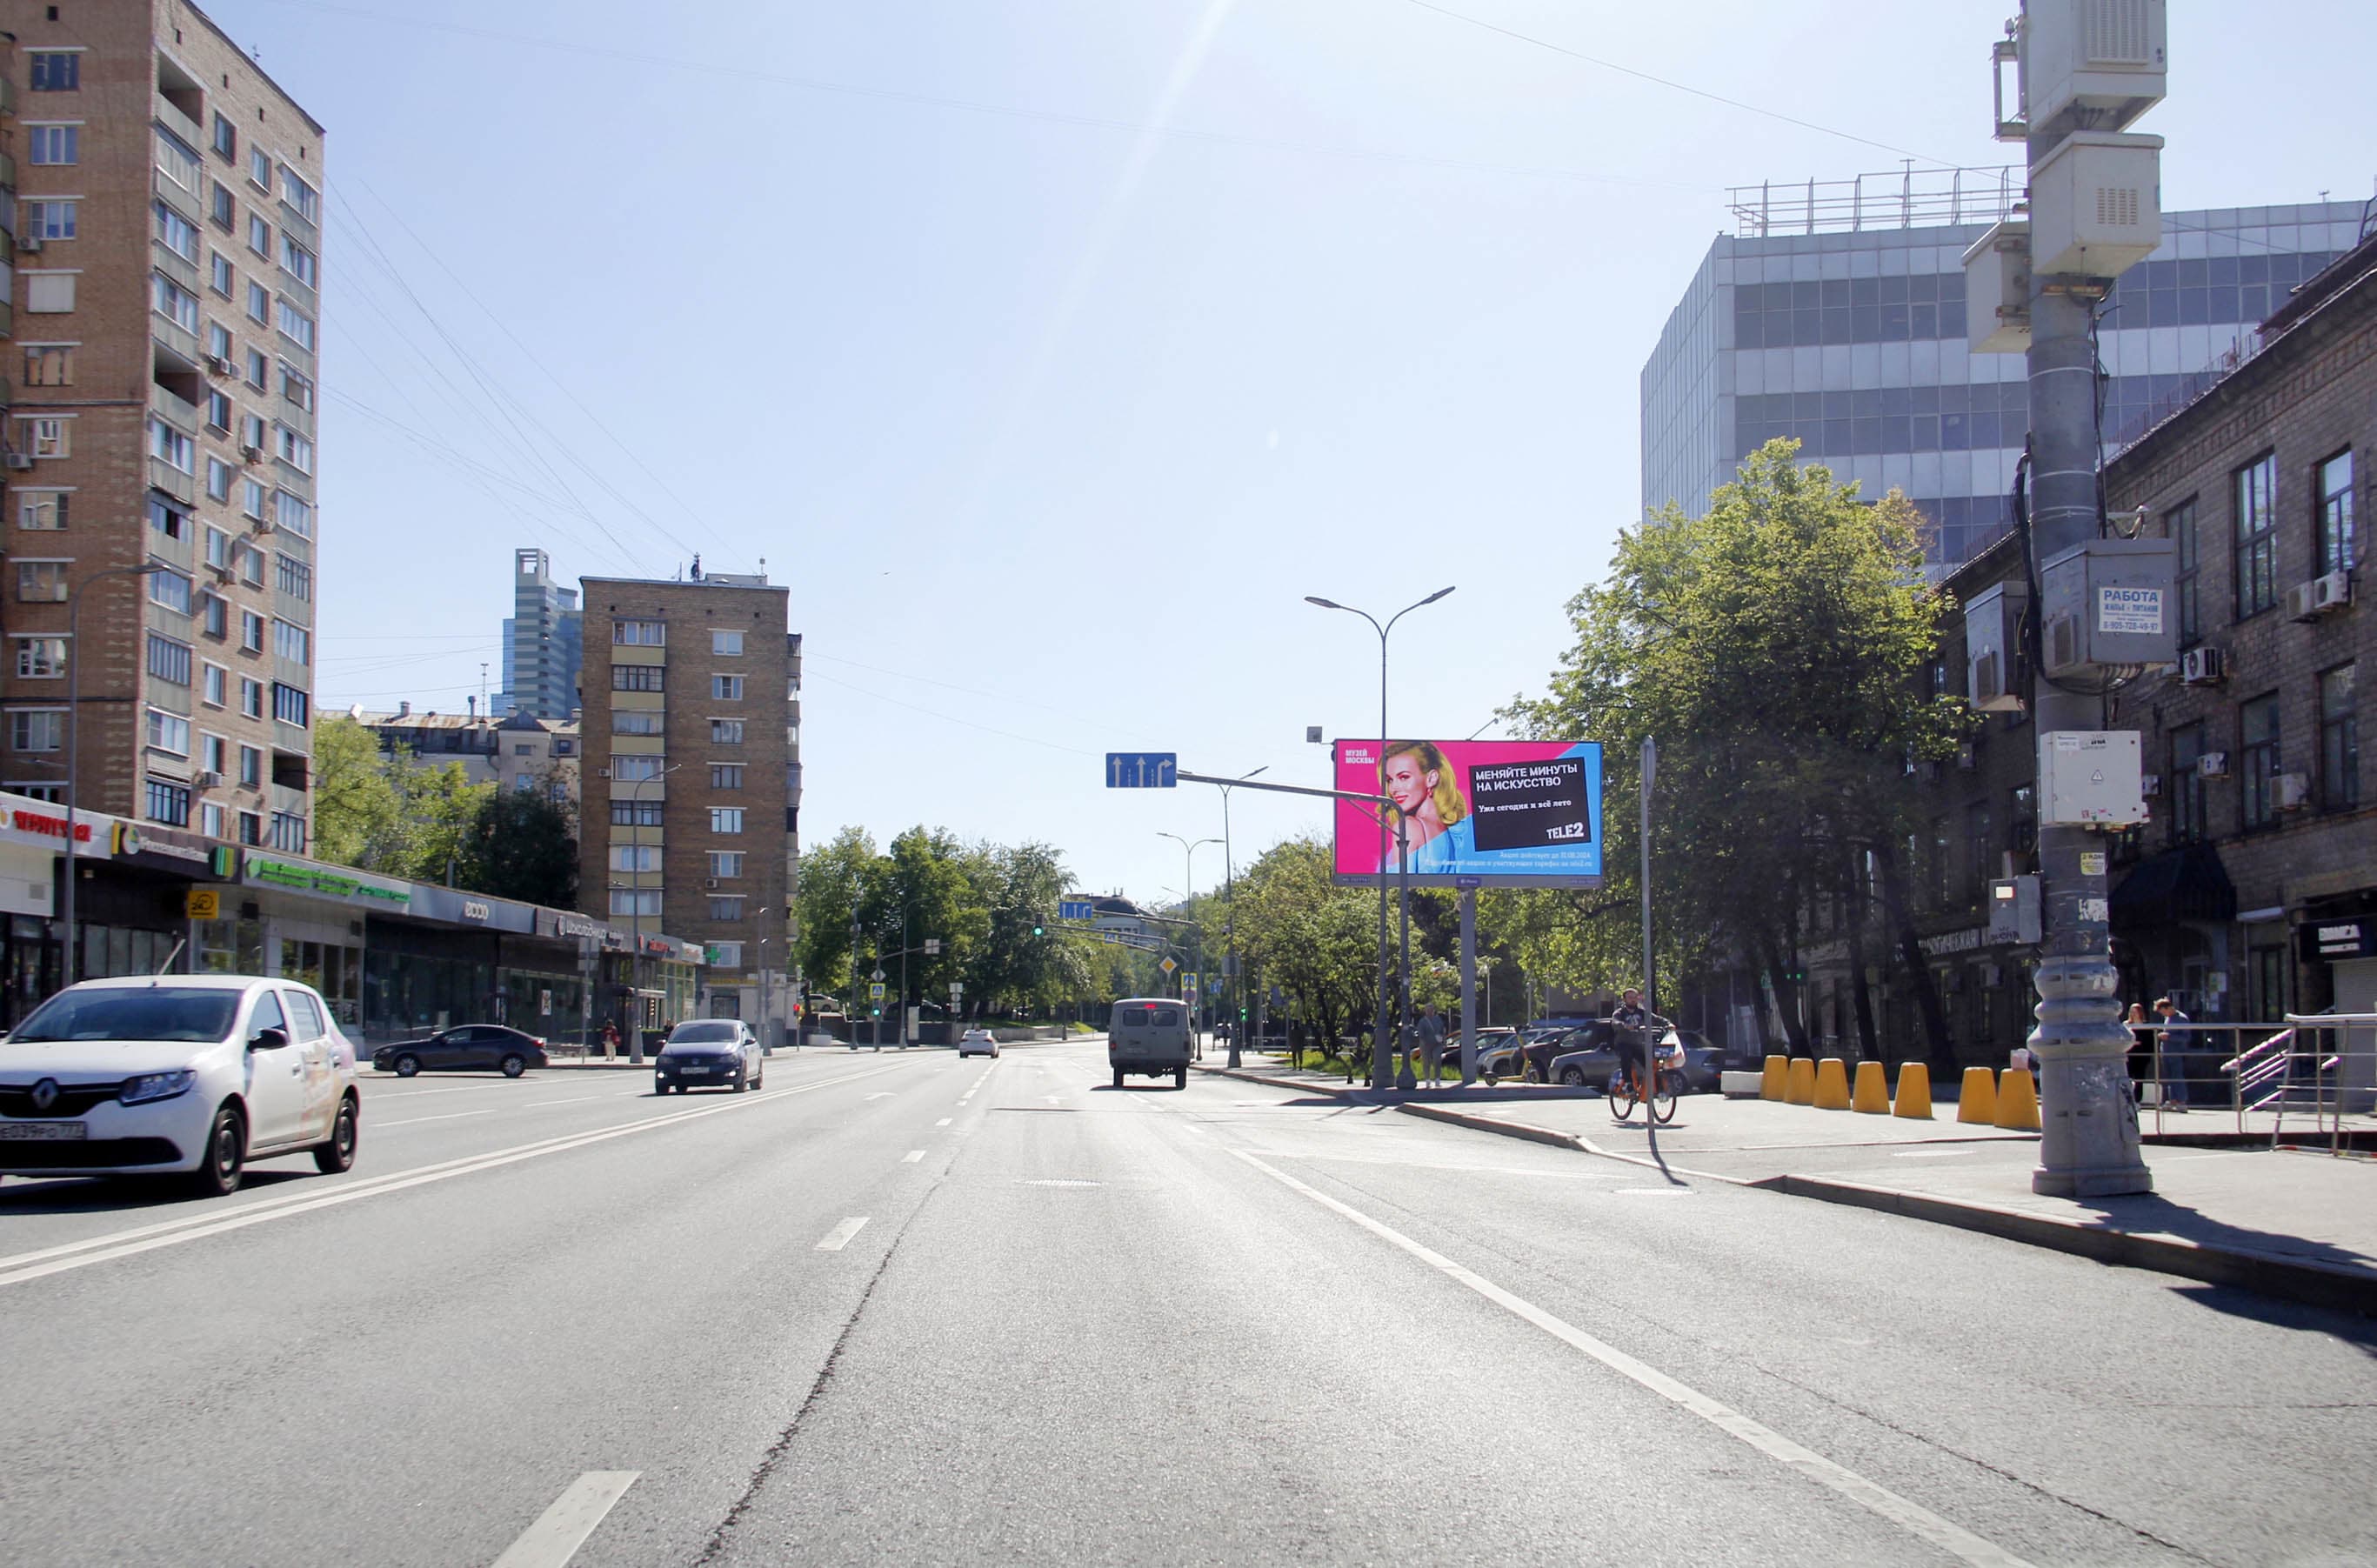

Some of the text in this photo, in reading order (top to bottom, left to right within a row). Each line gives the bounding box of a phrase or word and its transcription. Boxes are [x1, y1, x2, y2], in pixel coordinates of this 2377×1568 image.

[2104, 590, 2158, 602] РАБОТА
[1345, 748, 1367, 757] МУЗЕЙ
[1475, 764, 1578, 781] МЕНЯЙТЕ МИНУТЫ
[1477, 777, 1561, 791] НА ИСКУССТВО
[1478, 804, 1495, 813] Уже
[1497, 802, 1528, 811] сегодня
[1546, 822, 1585, 839] TELE2
